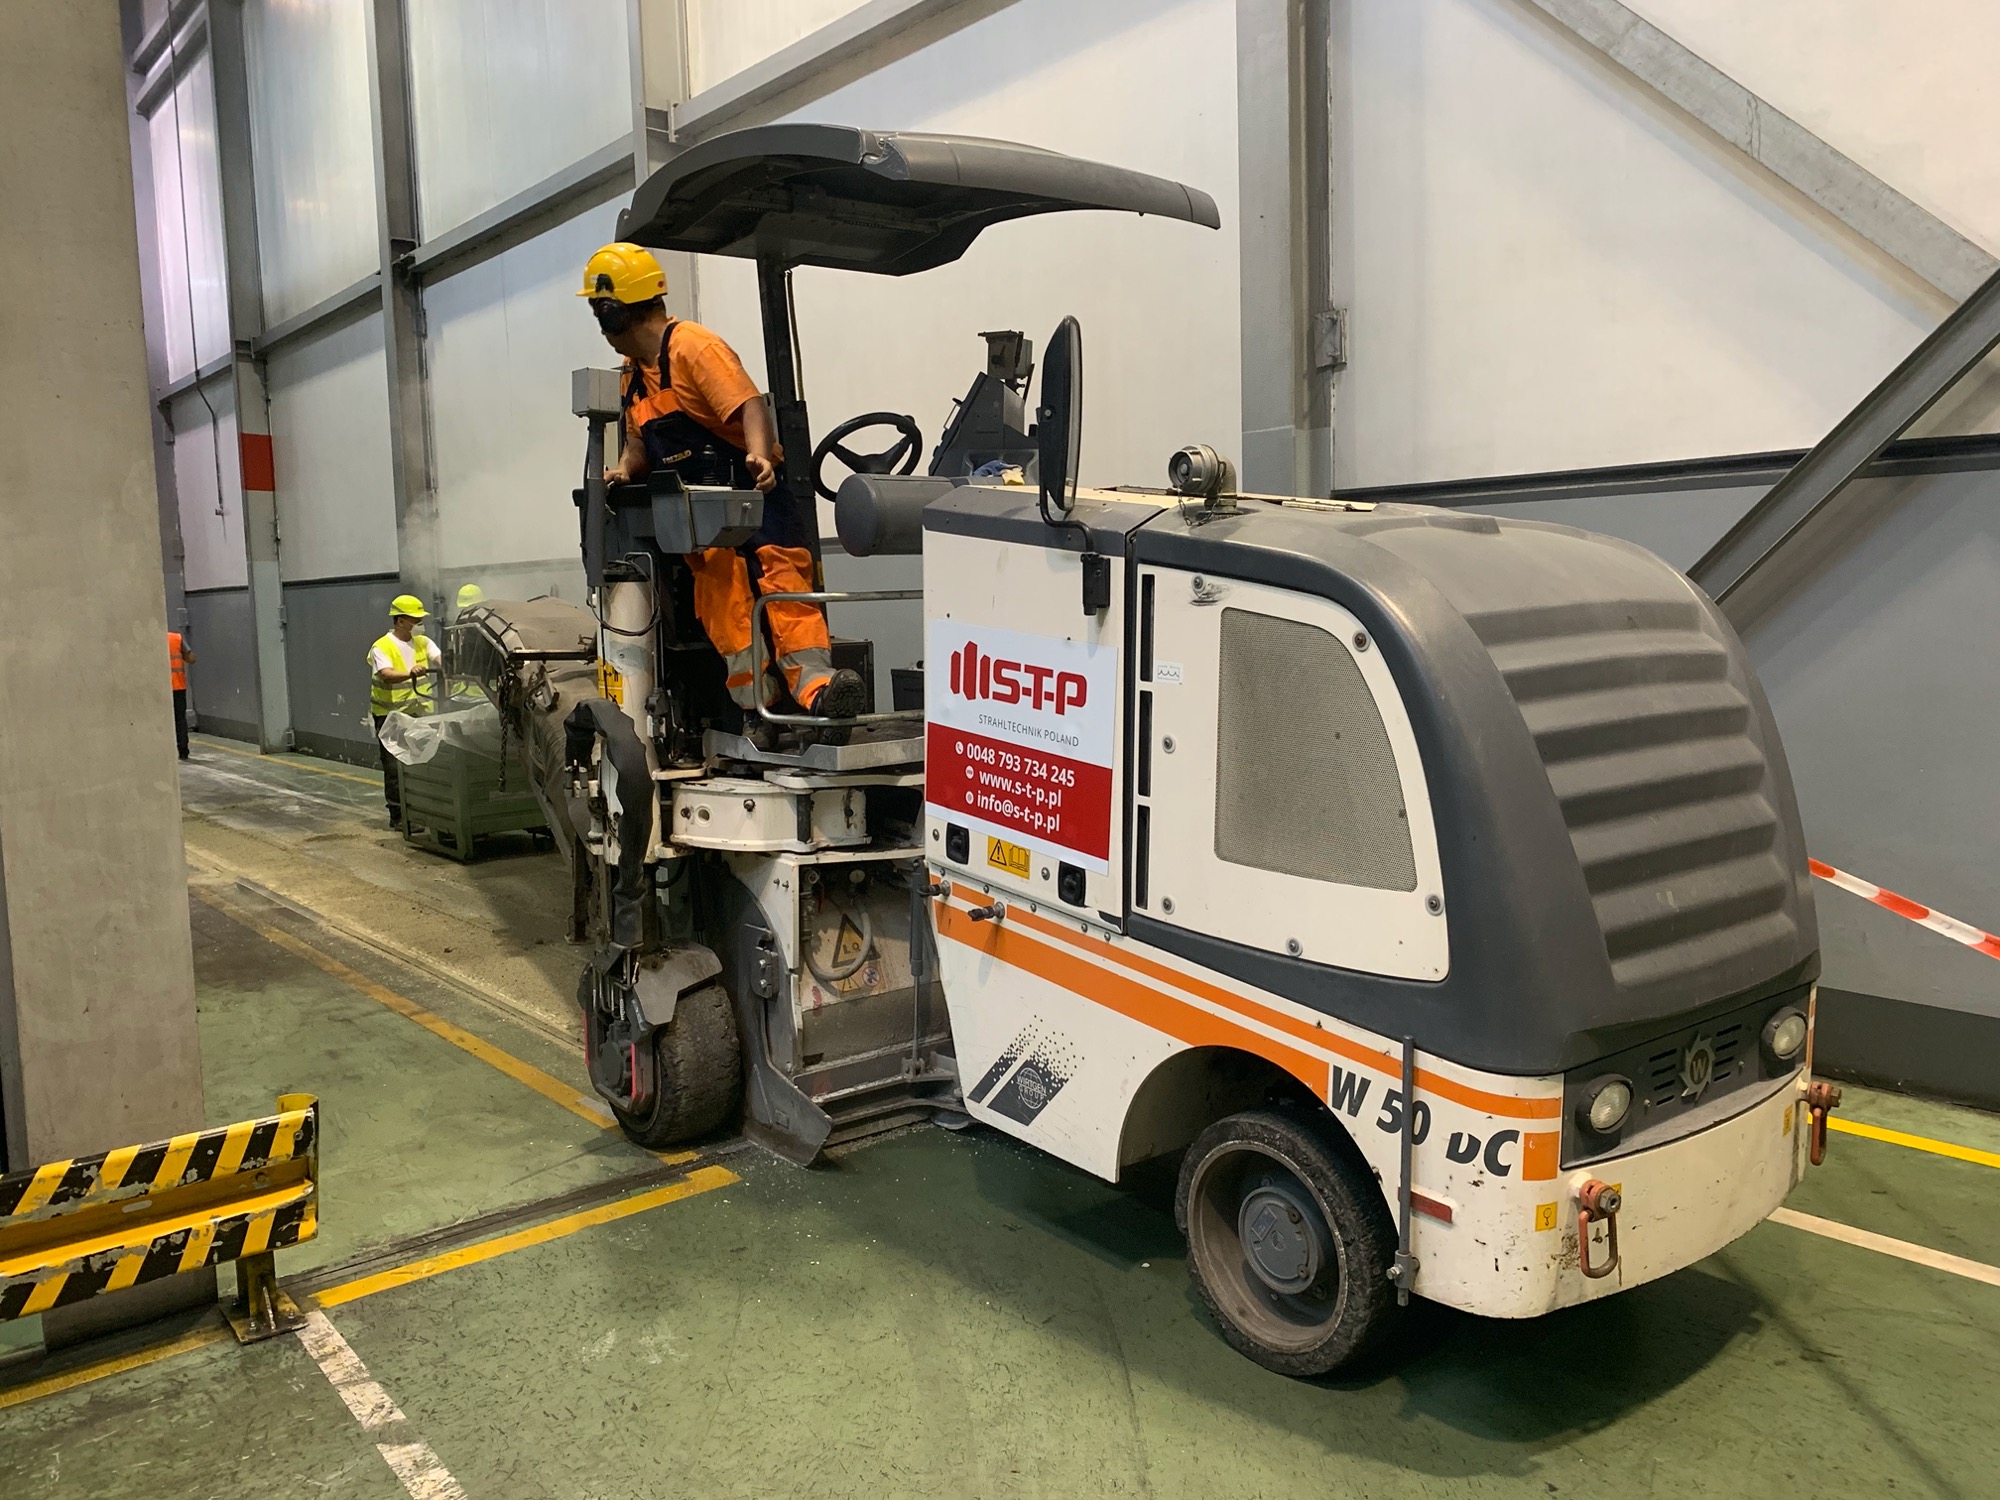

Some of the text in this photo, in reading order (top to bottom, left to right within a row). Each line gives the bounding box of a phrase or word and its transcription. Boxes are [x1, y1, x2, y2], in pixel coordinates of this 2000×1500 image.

[992, 659, 1087, 716] S-T-P
[978, 714, 1079, 747] STRAHLTECHNIK POLAND
[967, 743, 1075, 787] 0048 793 734 245
[979, 770, 1061, 810] www.s-t-p.pl
[977, 790, 1060, 834] info@s-t-p.pl
[1016, 1075, 1047, 1095] WIRTGEN
[1018, 1085, 1045, 1101] GROUP
[1331, 1064, 1371, 1118] W
[1376, 1088, 1431, 1146] 50
